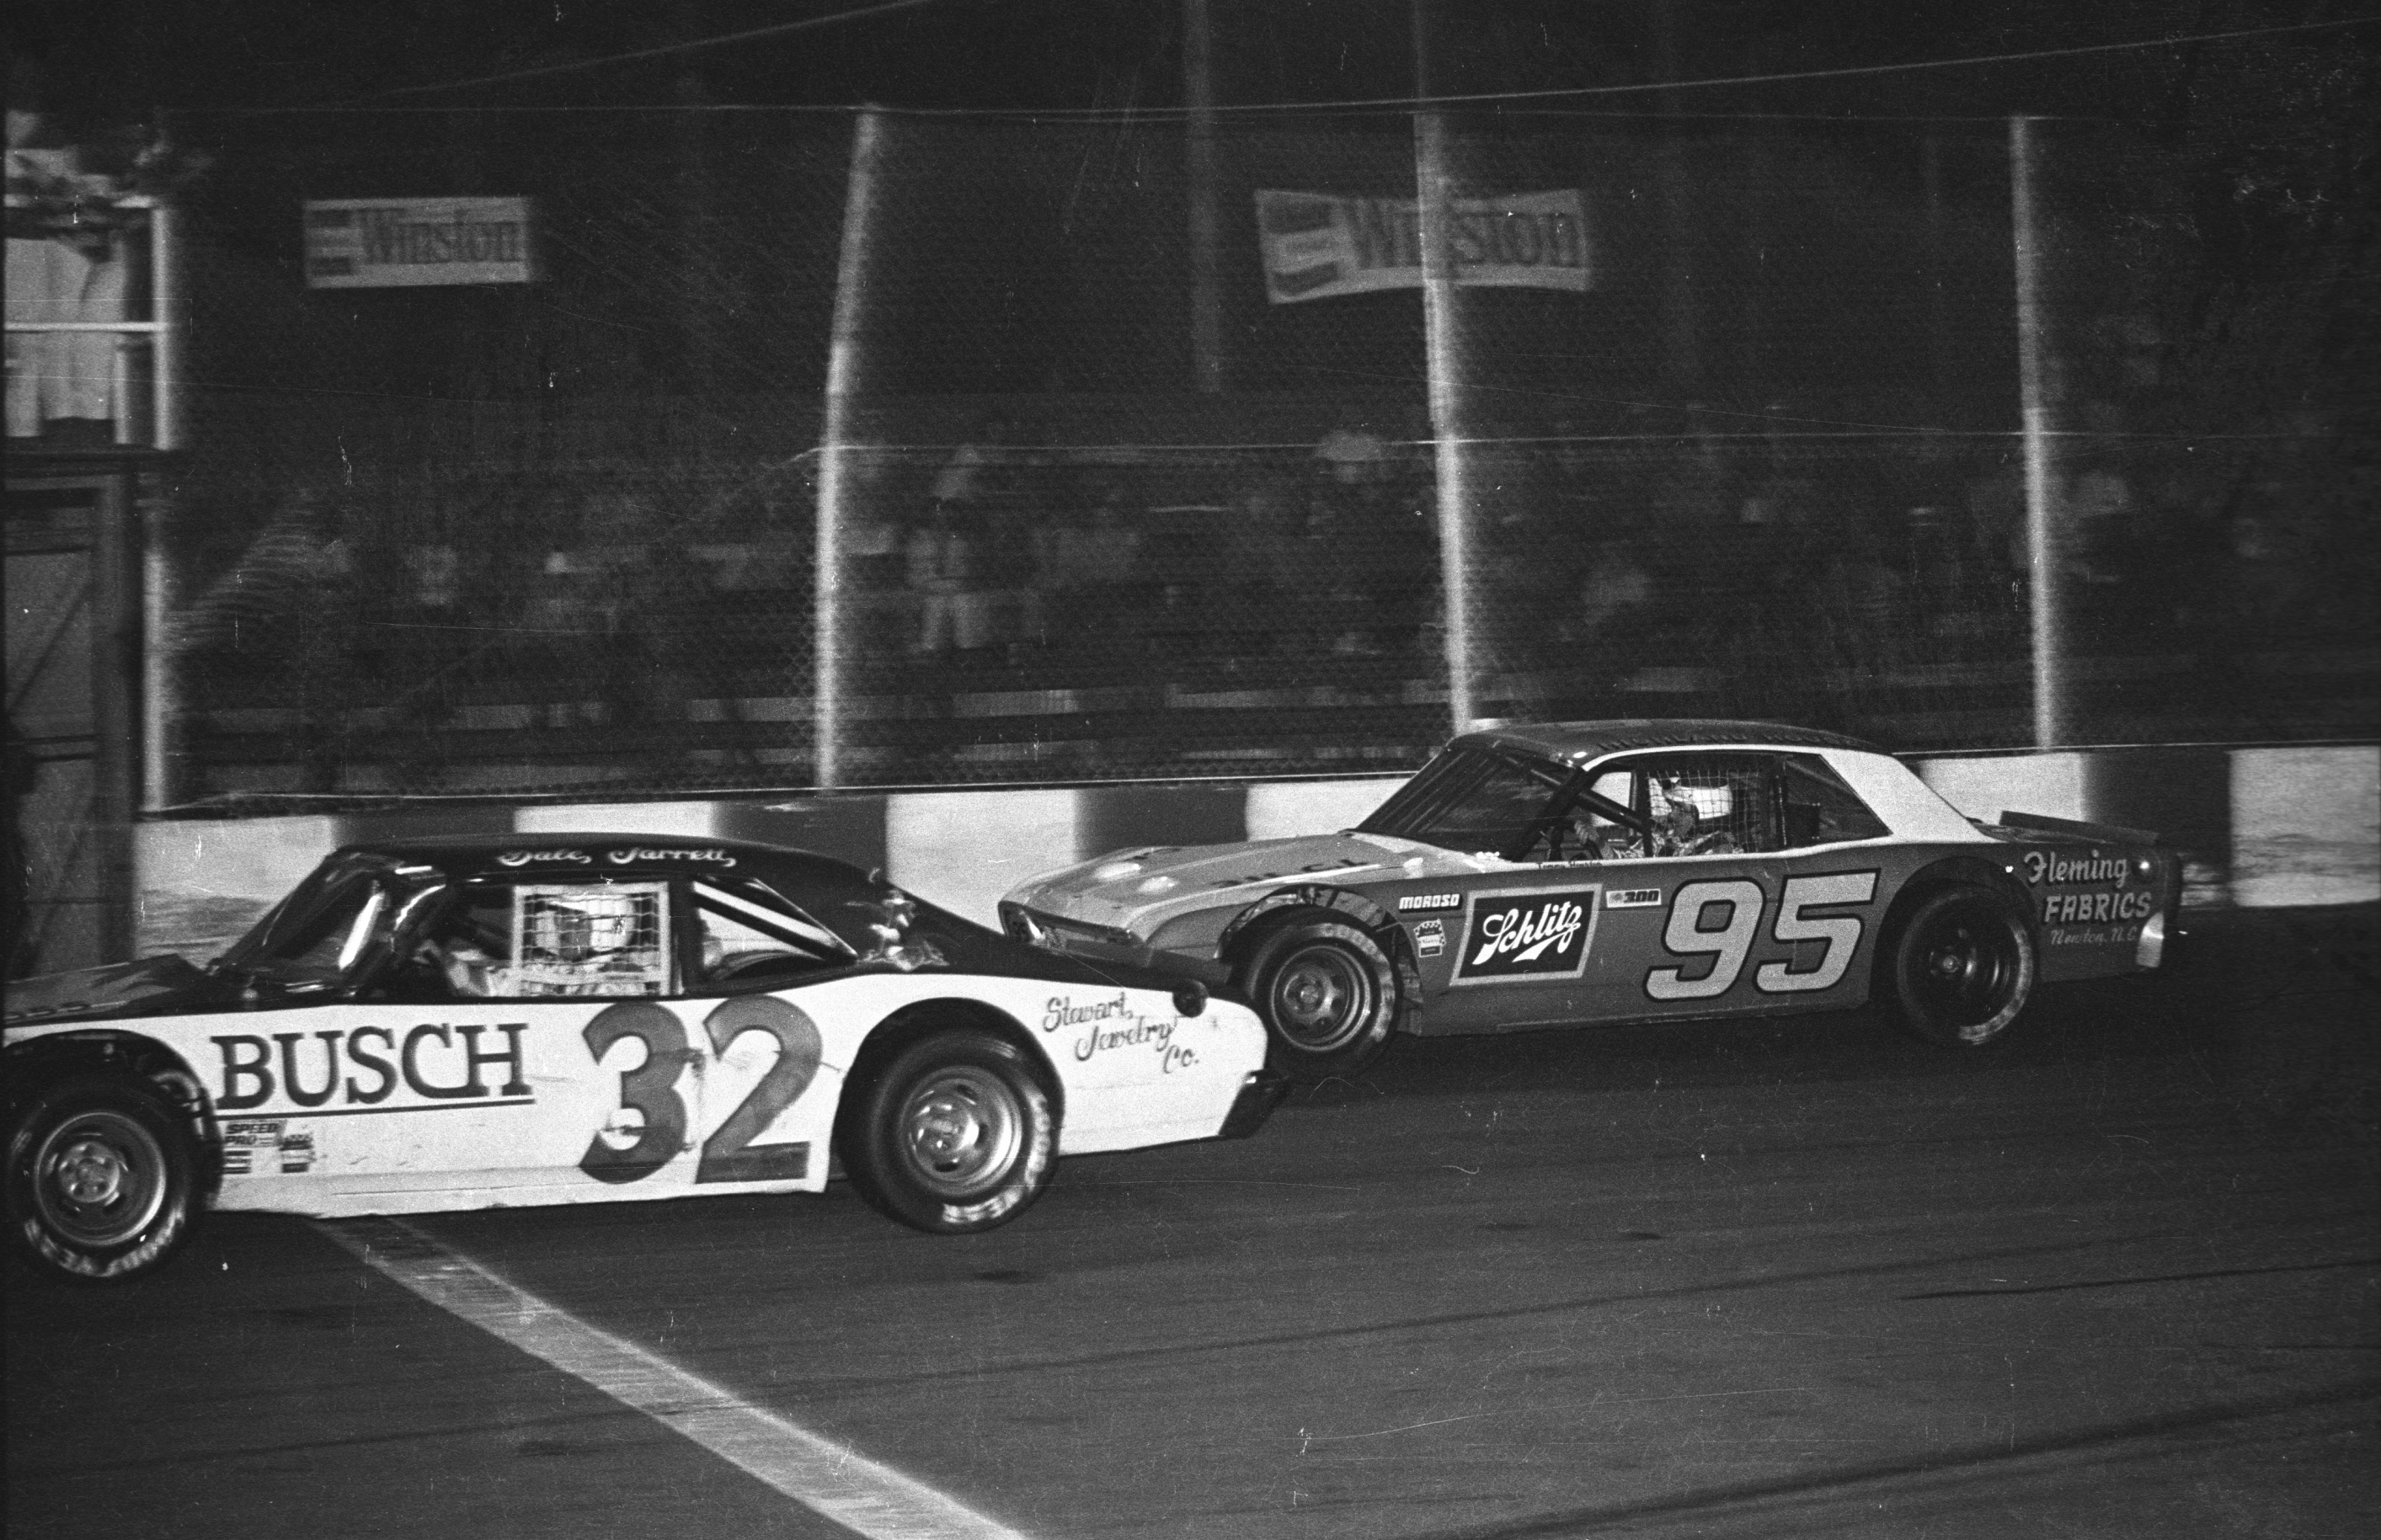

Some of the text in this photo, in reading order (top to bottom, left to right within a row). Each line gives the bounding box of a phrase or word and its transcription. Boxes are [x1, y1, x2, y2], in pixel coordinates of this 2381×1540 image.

[2023, 851, 2128, 889] Fleming
[1471, 901, 1583, 966] Schlitz
[1644, 867, 1881, 1002] 95
[2044, 893, 2152, 922] FABRICS
[211, 1023, 533, 1110] BUSCH
[578, 995, 823, 1186] 32
[1163, 1044, 1199, 1074] Co.
